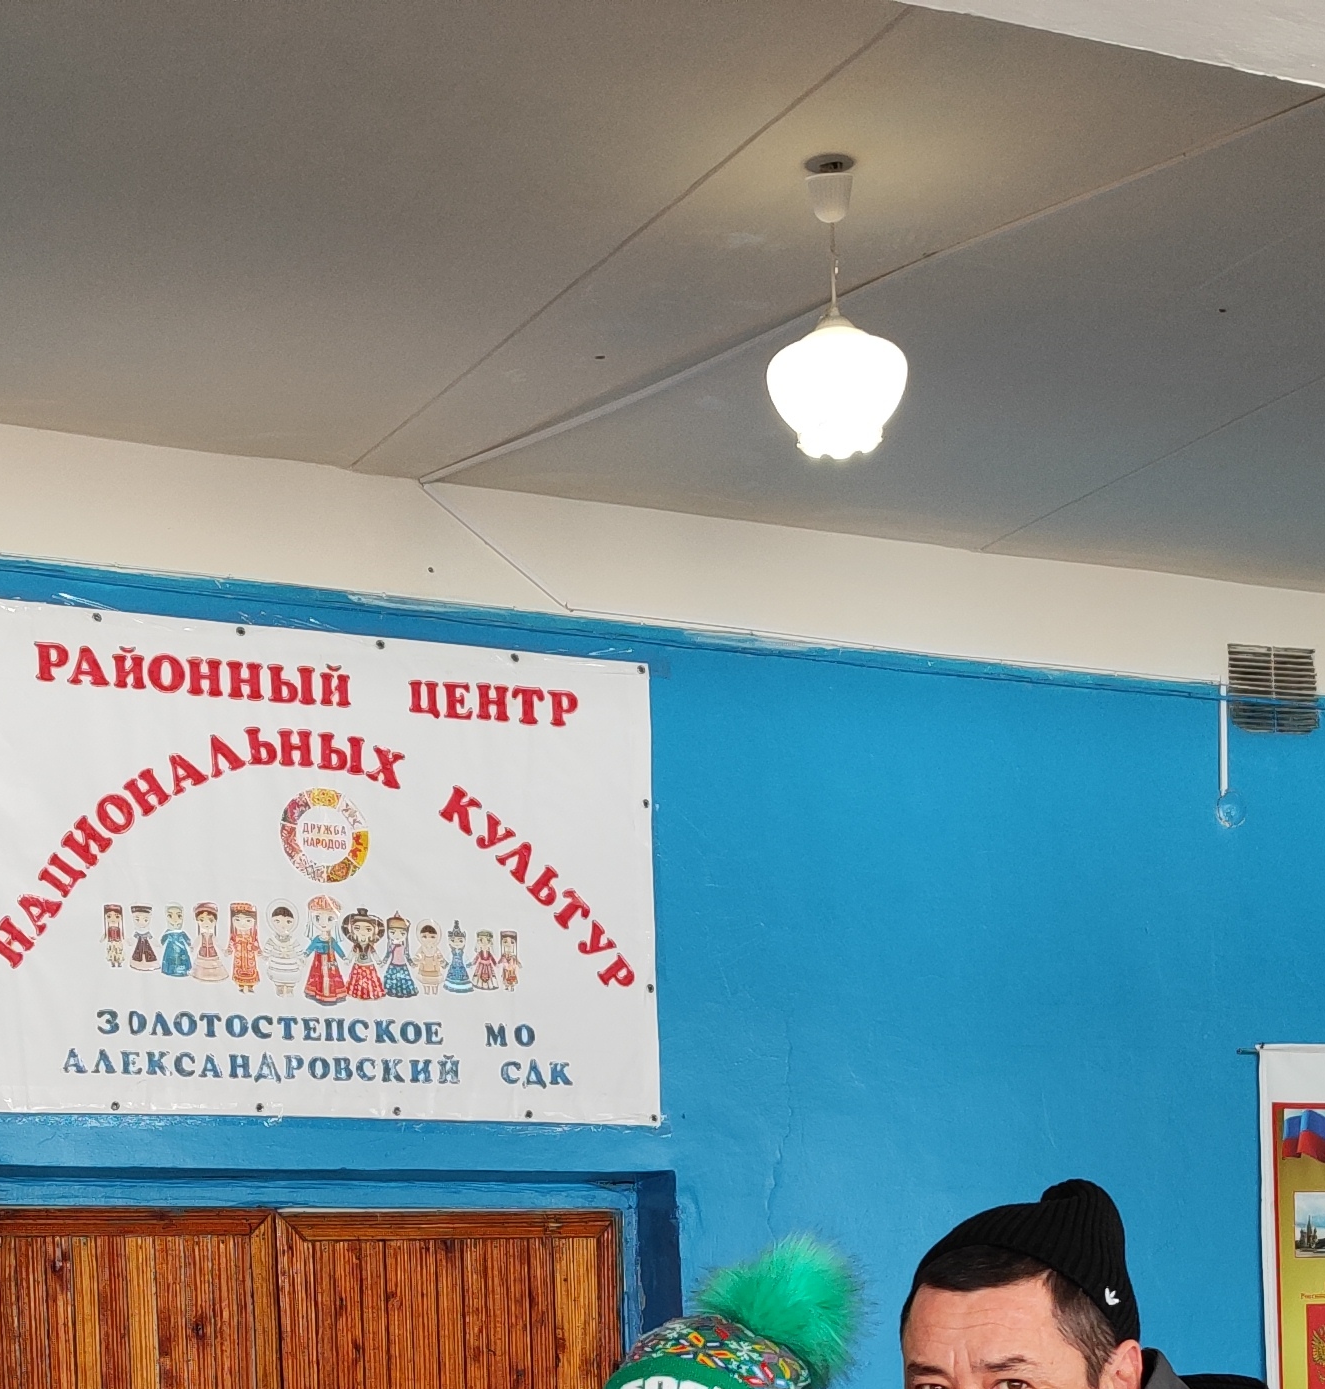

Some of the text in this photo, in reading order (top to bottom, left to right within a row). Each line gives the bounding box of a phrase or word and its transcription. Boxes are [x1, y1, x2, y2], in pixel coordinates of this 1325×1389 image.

[34, 641, 579, 727] РАЙОННЫЙ ЦЕНТР
[302, 822, 347, 836] ДРУЖБА
[302, 837, 347, 851] НАРОДОВ
[439, 785, 636, 990] КУЛЬТУР
[96, 1009, 536, 1048] ЗОЛОТОСТЕПСКОЕ МО
[62, 1048, 574, 1088] АЛЕКСАНДРОВСКИЙ СДК
